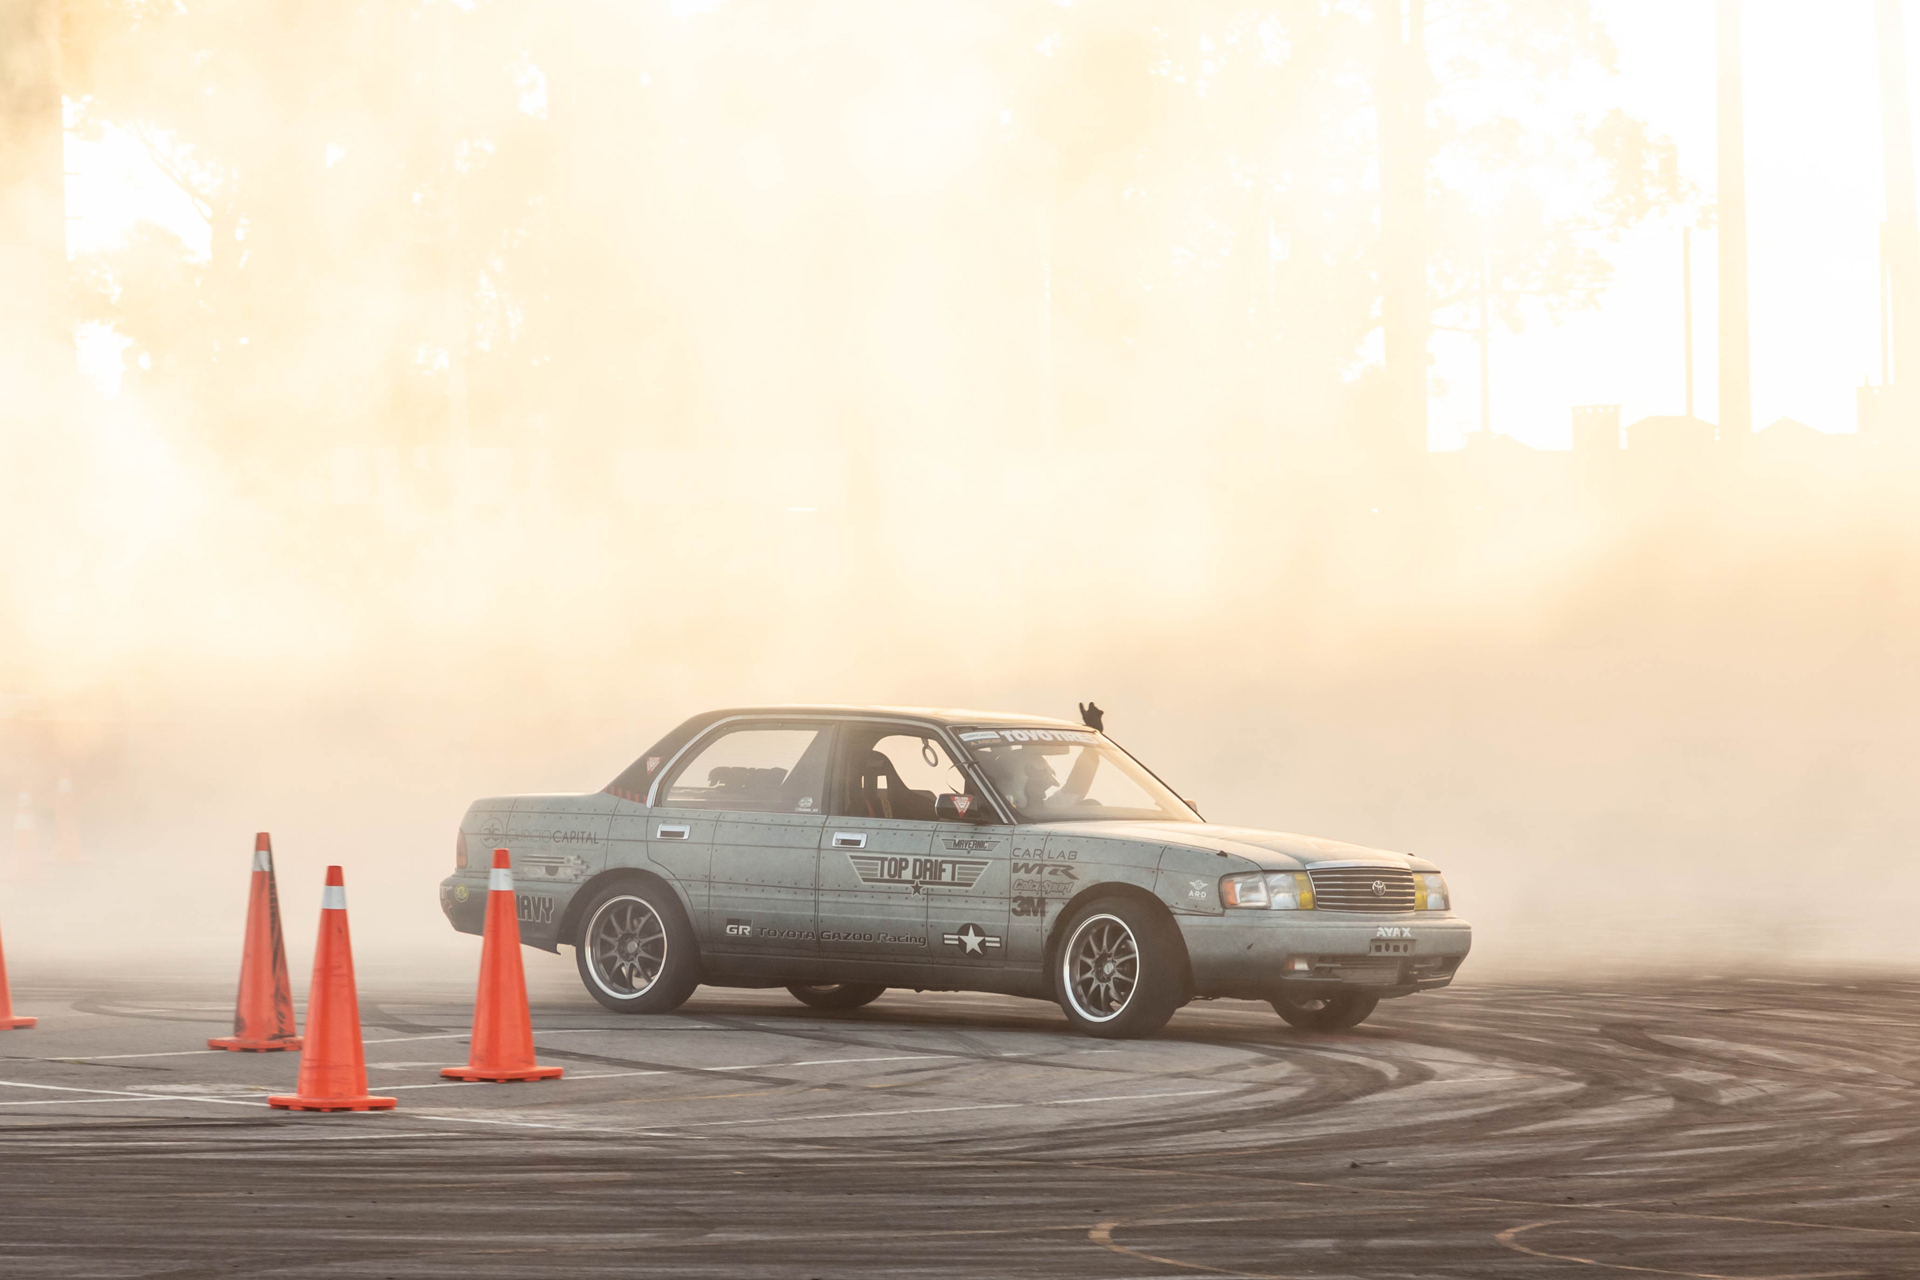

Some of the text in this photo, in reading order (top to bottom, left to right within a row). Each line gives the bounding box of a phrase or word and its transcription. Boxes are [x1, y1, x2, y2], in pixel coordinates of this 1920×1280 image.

[1012, 847, 1078, 860] CAR LAB
[880, 857, 956, 881] TOP DRIFT
[1188, 889, 1207, 898] ARD
[1011, 895, 1046, 917] 3M
[726, 924, 751, 936] GR
[877, 932, 928, 948] Racing
